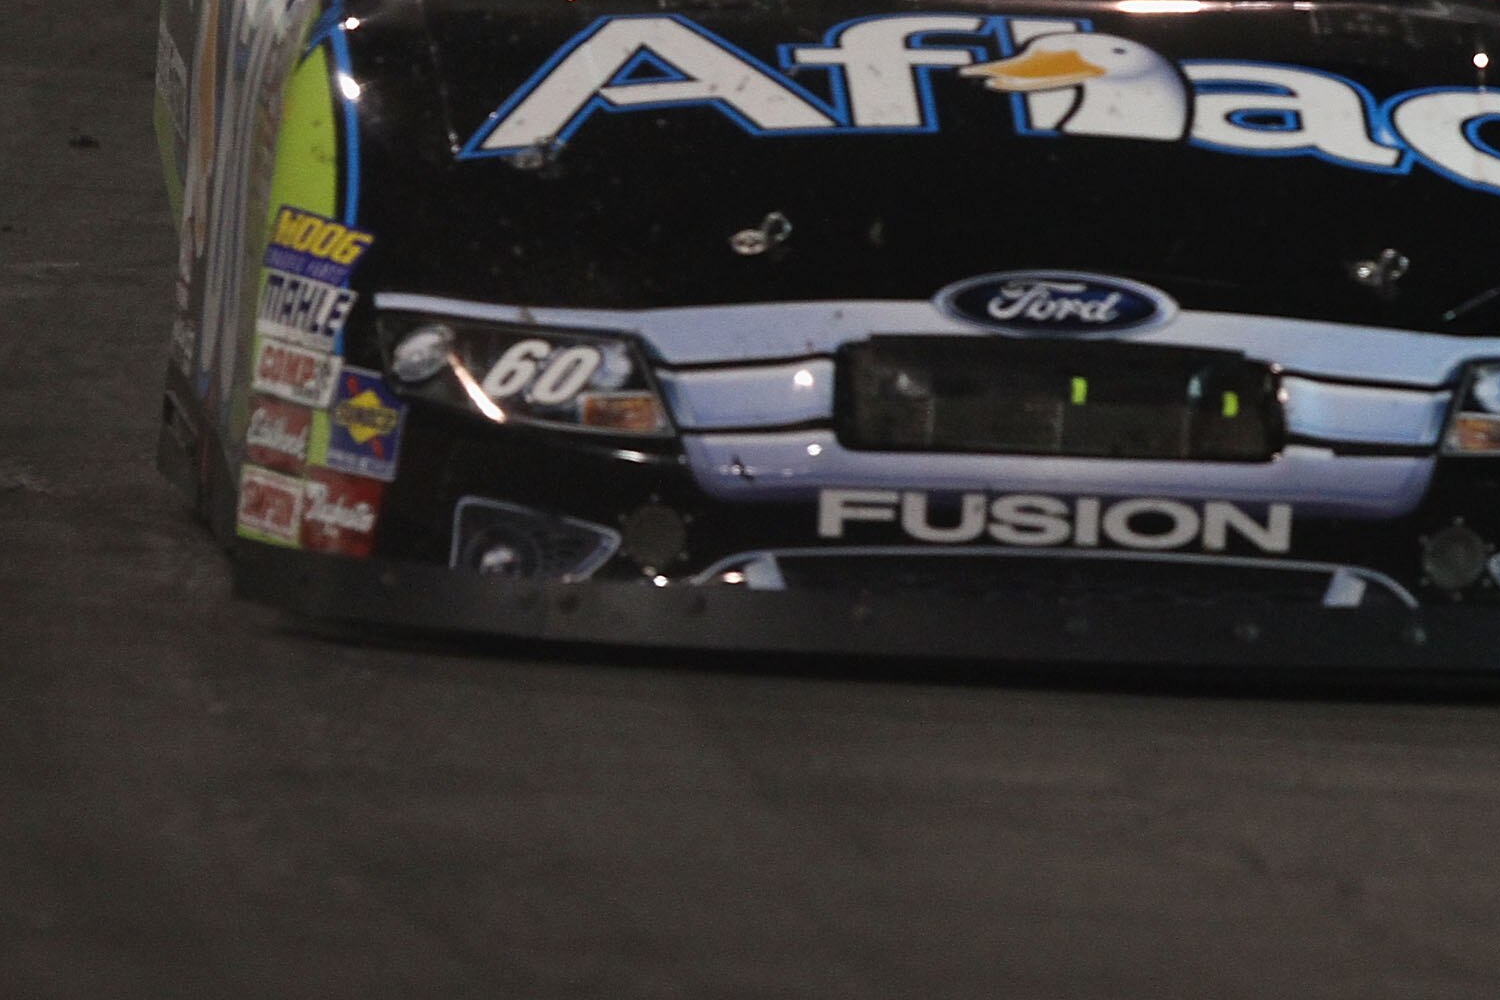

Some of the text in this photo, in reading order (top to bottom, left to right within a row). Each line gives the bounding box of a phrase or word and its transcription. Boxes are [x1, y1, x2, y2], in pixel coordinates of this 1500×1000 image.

[273, 209, 377, 266] MOOG
[262, 274, 351, 338] MAHLE
[987, 280, 1121, 323] Ford
[482, 338, 601, 405] 60
[817, 488, 1294, 554] FUSION
